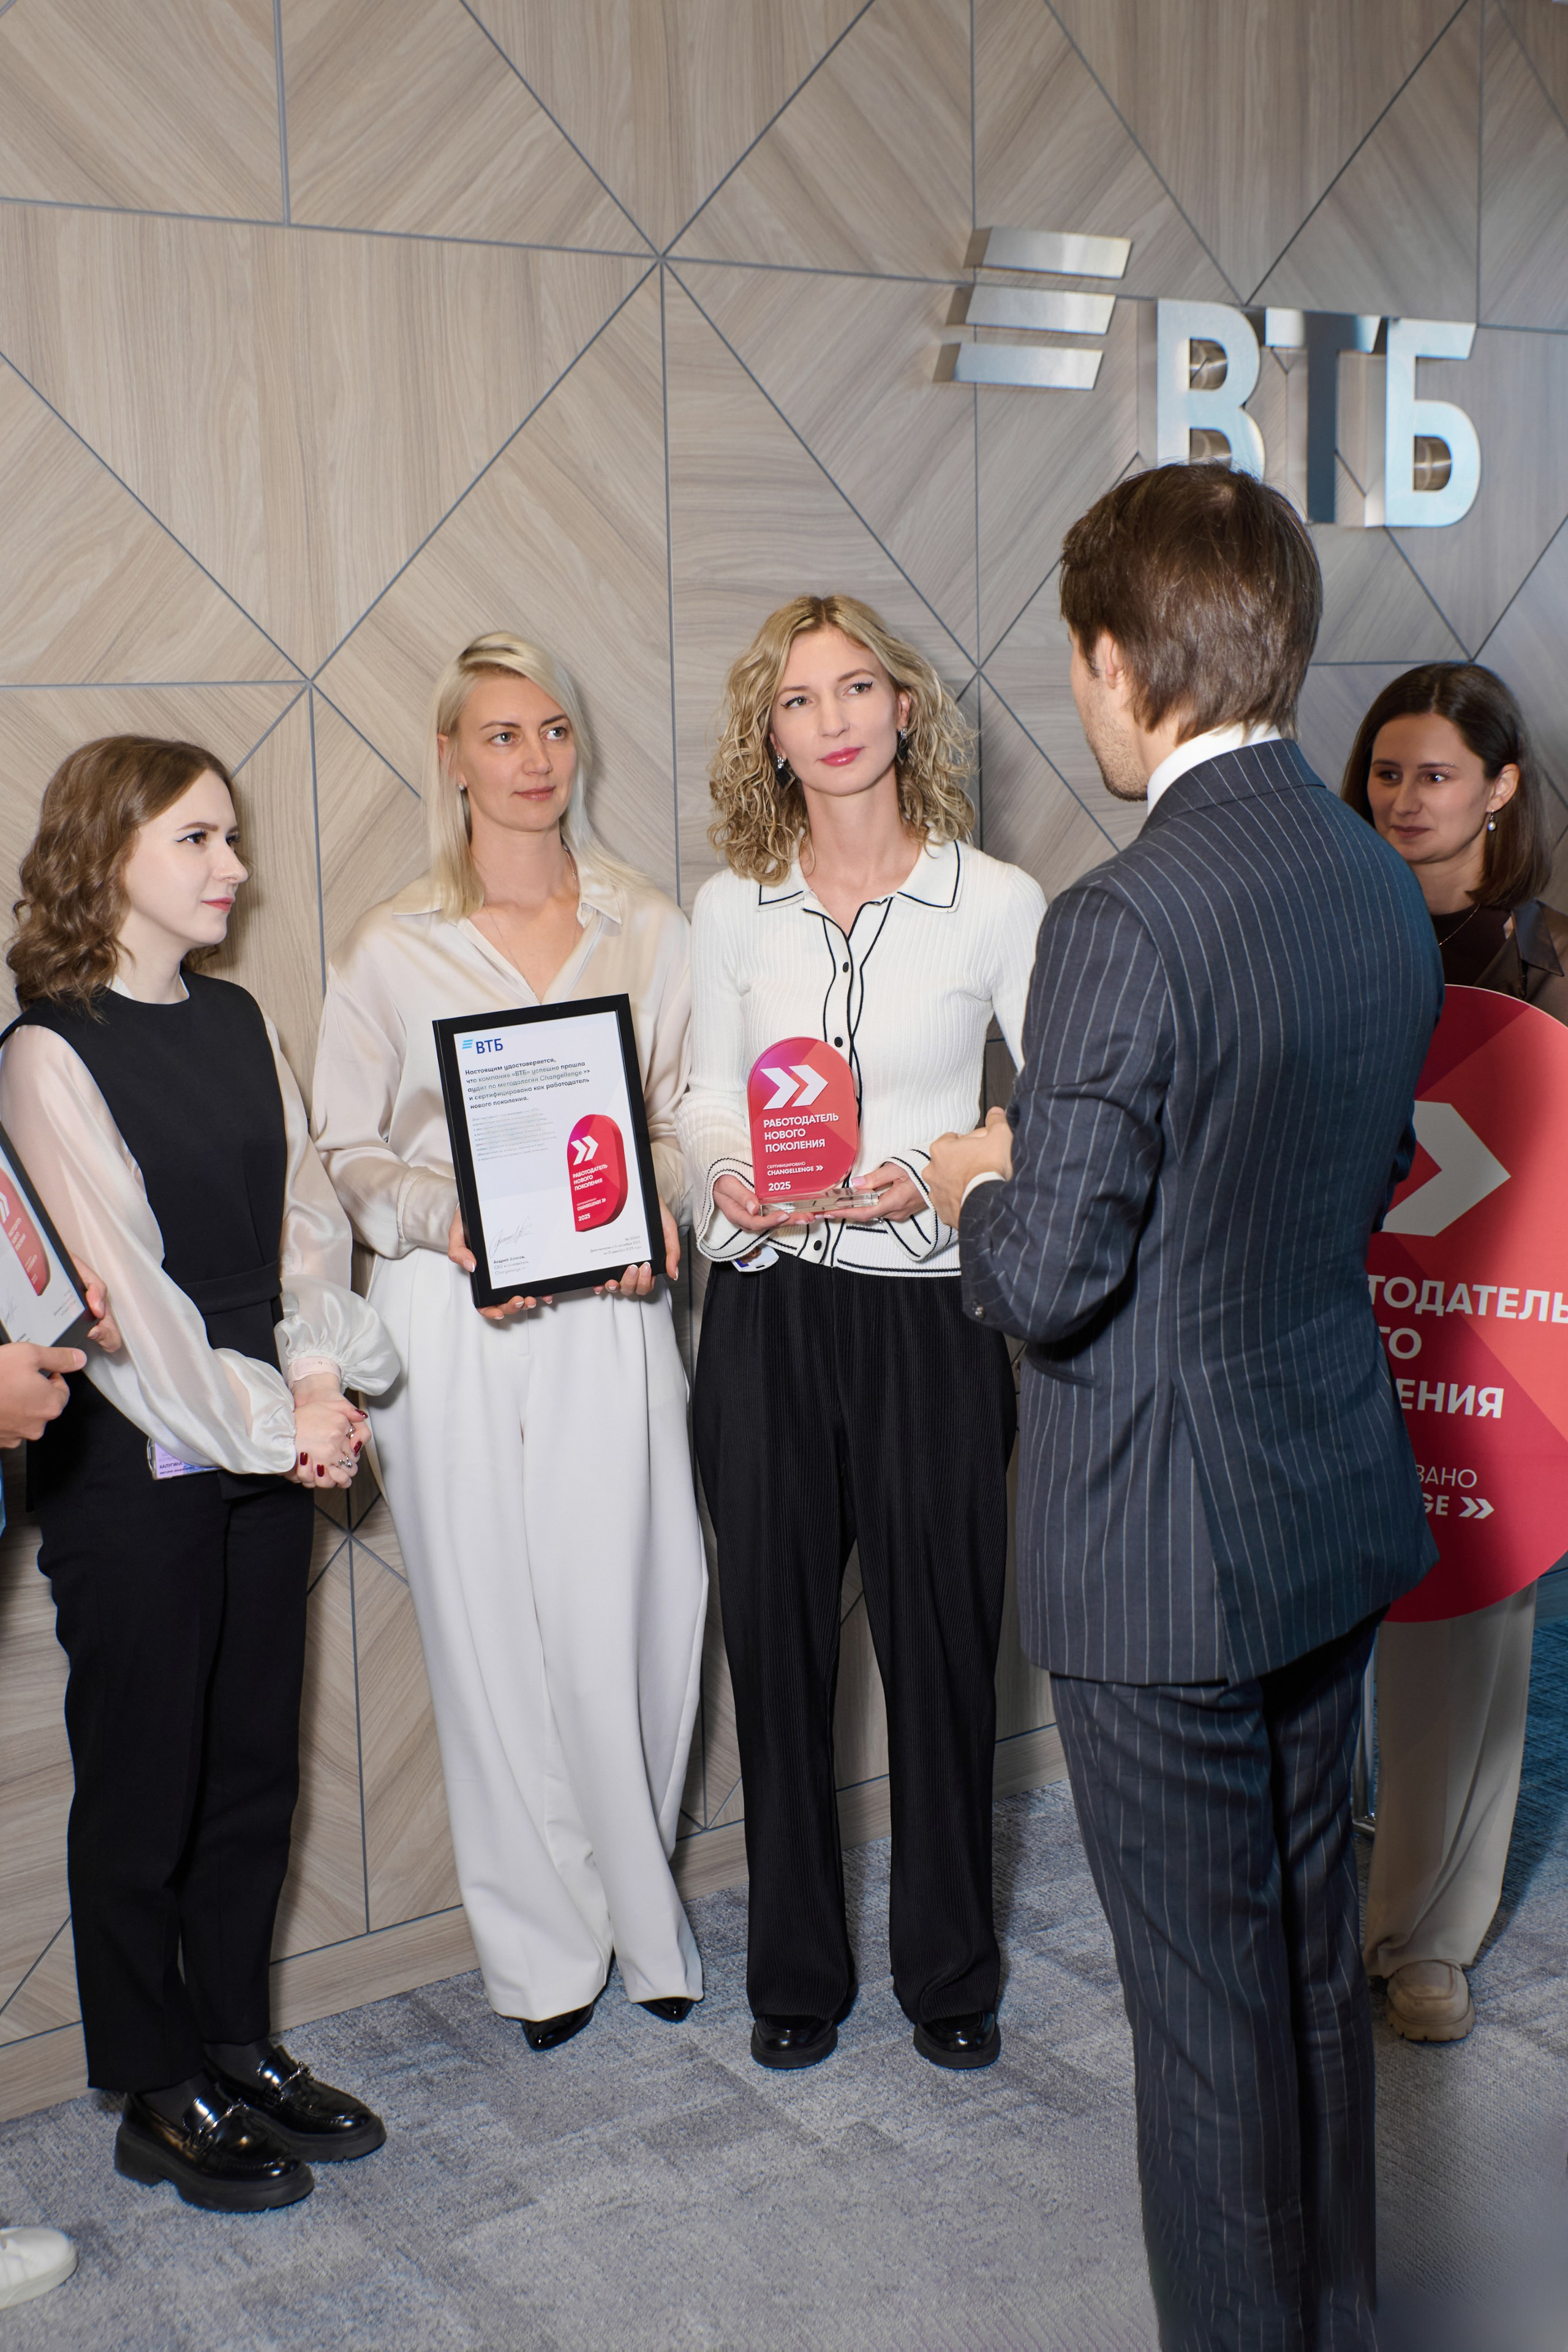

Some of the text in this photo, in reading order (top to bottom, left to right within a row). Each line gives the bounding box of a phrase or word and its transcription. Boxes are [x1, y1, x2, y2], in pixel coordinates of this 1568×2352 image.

[1156, 298, 1481, 528] ВТБ
[475, 1038, 503, 1054] ВТБ
[465, 1058, 556, 1076] Настоящим удостоверяется,
[478, 1073, 510, 1083] компания
[531, 1065, 559, 1076] успешно
[560, 1061, 586, 1070] прошла
[467, 1085, 487, 1094] аудит
[497, 1077, 539, 1088] методологии
[540, 1070, 582, 1081] Changellenge
[474, 1087, 532, 1101] сертифицирована
[546, 1077, 590, 1090] работодатель
[470, 1096, 529, 1110] нового поколения.
[763, 1112, 839, 1129] РАБОТОДАТЕЛЬ
[764, 1128, 806, 1140] НОВОГО
[765, 1138, 826, 1153] ПОКОЛЕНИЯ
[573, 1164, 608, 1179] РАБОТОДАТЕЛЬ
[767, 1161, 806, 1169] СЕРТИФИЦИРОВАНО
[767, 1166, 815, 1176] CHANGELLENGE
[573, 1175, 594, 1185] НОВОГО
[575, 1178, 603, 1191] ПОКОЛЕНИЯ
[768, 1180, 791, 1192] 2025
[578, 1213, 590, 1221] 2025
